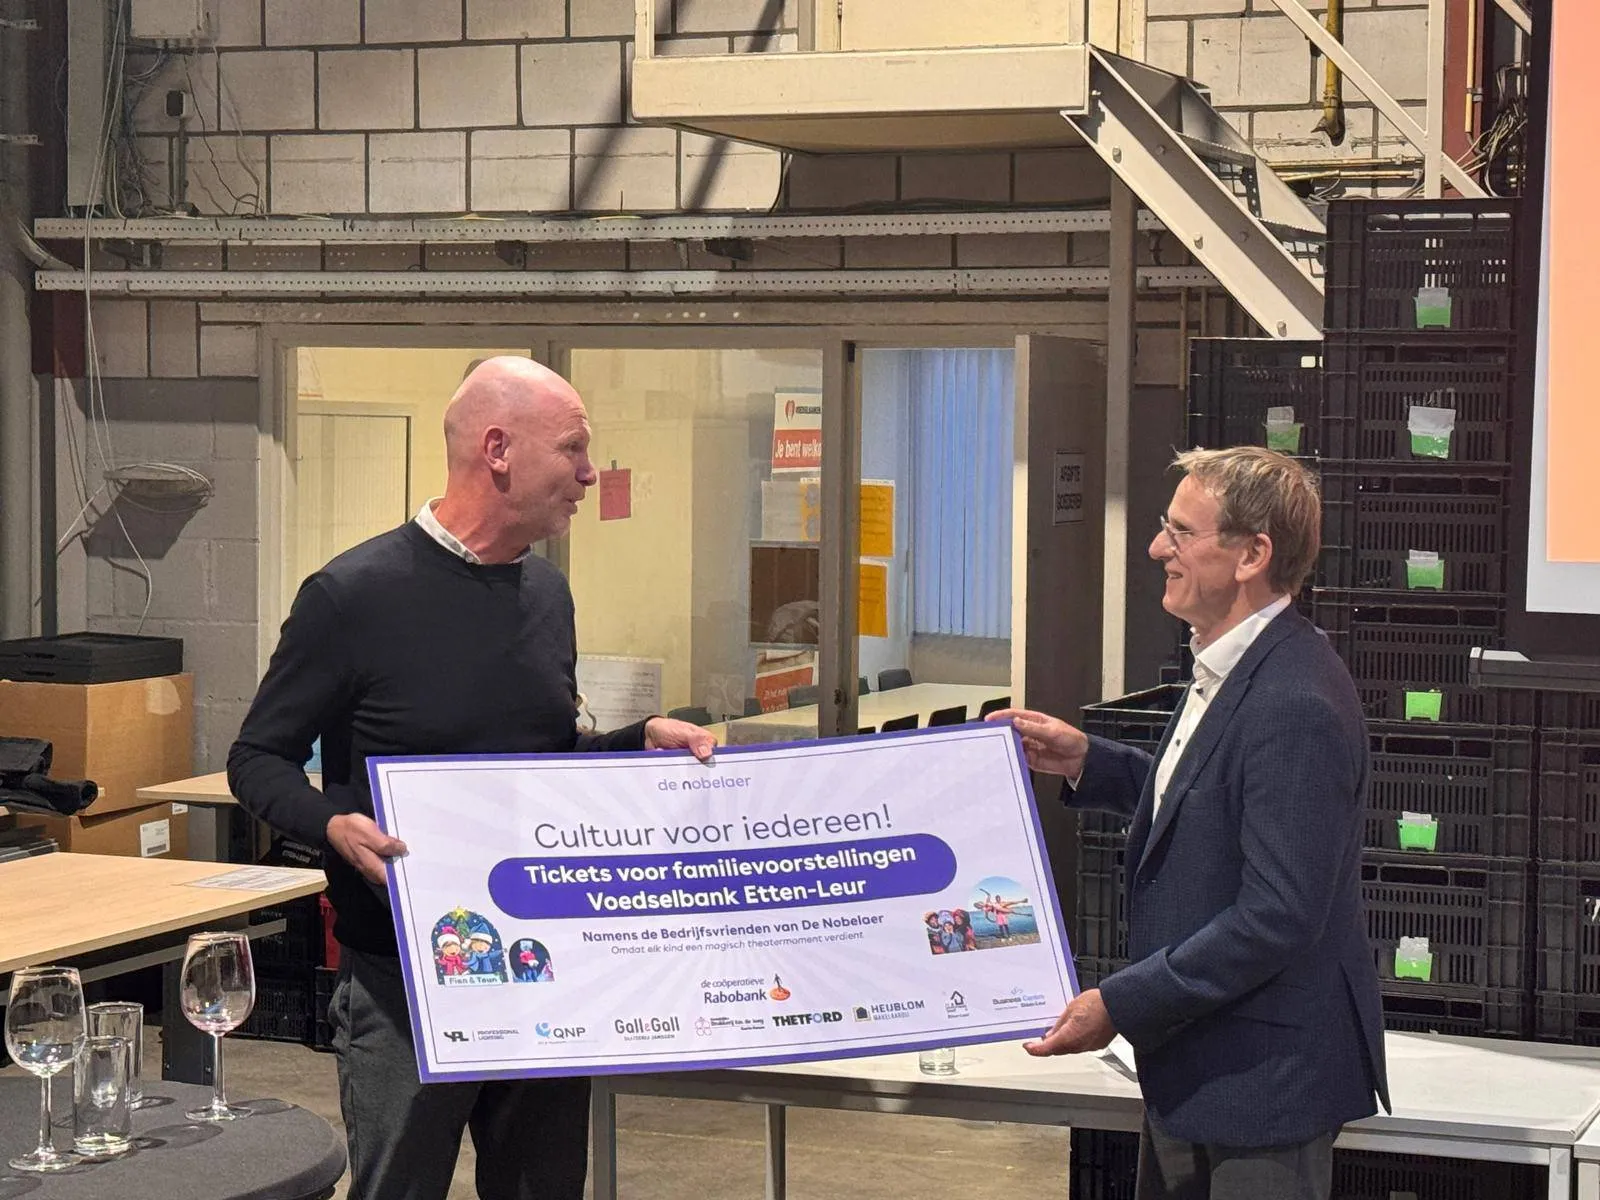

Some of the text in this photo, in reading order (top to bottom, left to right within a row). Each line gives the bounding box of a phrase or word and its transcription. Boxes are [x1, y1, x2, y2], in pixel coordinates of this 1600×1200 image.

[785, 440, 801, 457] bent
[658, 776, 752, 791] de nobelaer
[535, 803, 892, 848] Cultuur voor iedereen!
[524, 847, 917, 884] Tickets voor familievoorstellingen
[586, 879, 867, 911] Voedselbank Etten-Leur
[583, 915, 885, 942] Namens de Bedrijfsvrienden van De Nobelaer
[611, 931, 863, 955] Omdat elk kind een magisch theatermoment verdient
[700, 978, 765, 989] de coöperatieve
[704, 989, 767, 1004] Rabobank
[772, 1011, 843, 1027] THETFORD
[553, 1027, 586, 1039] QNP
